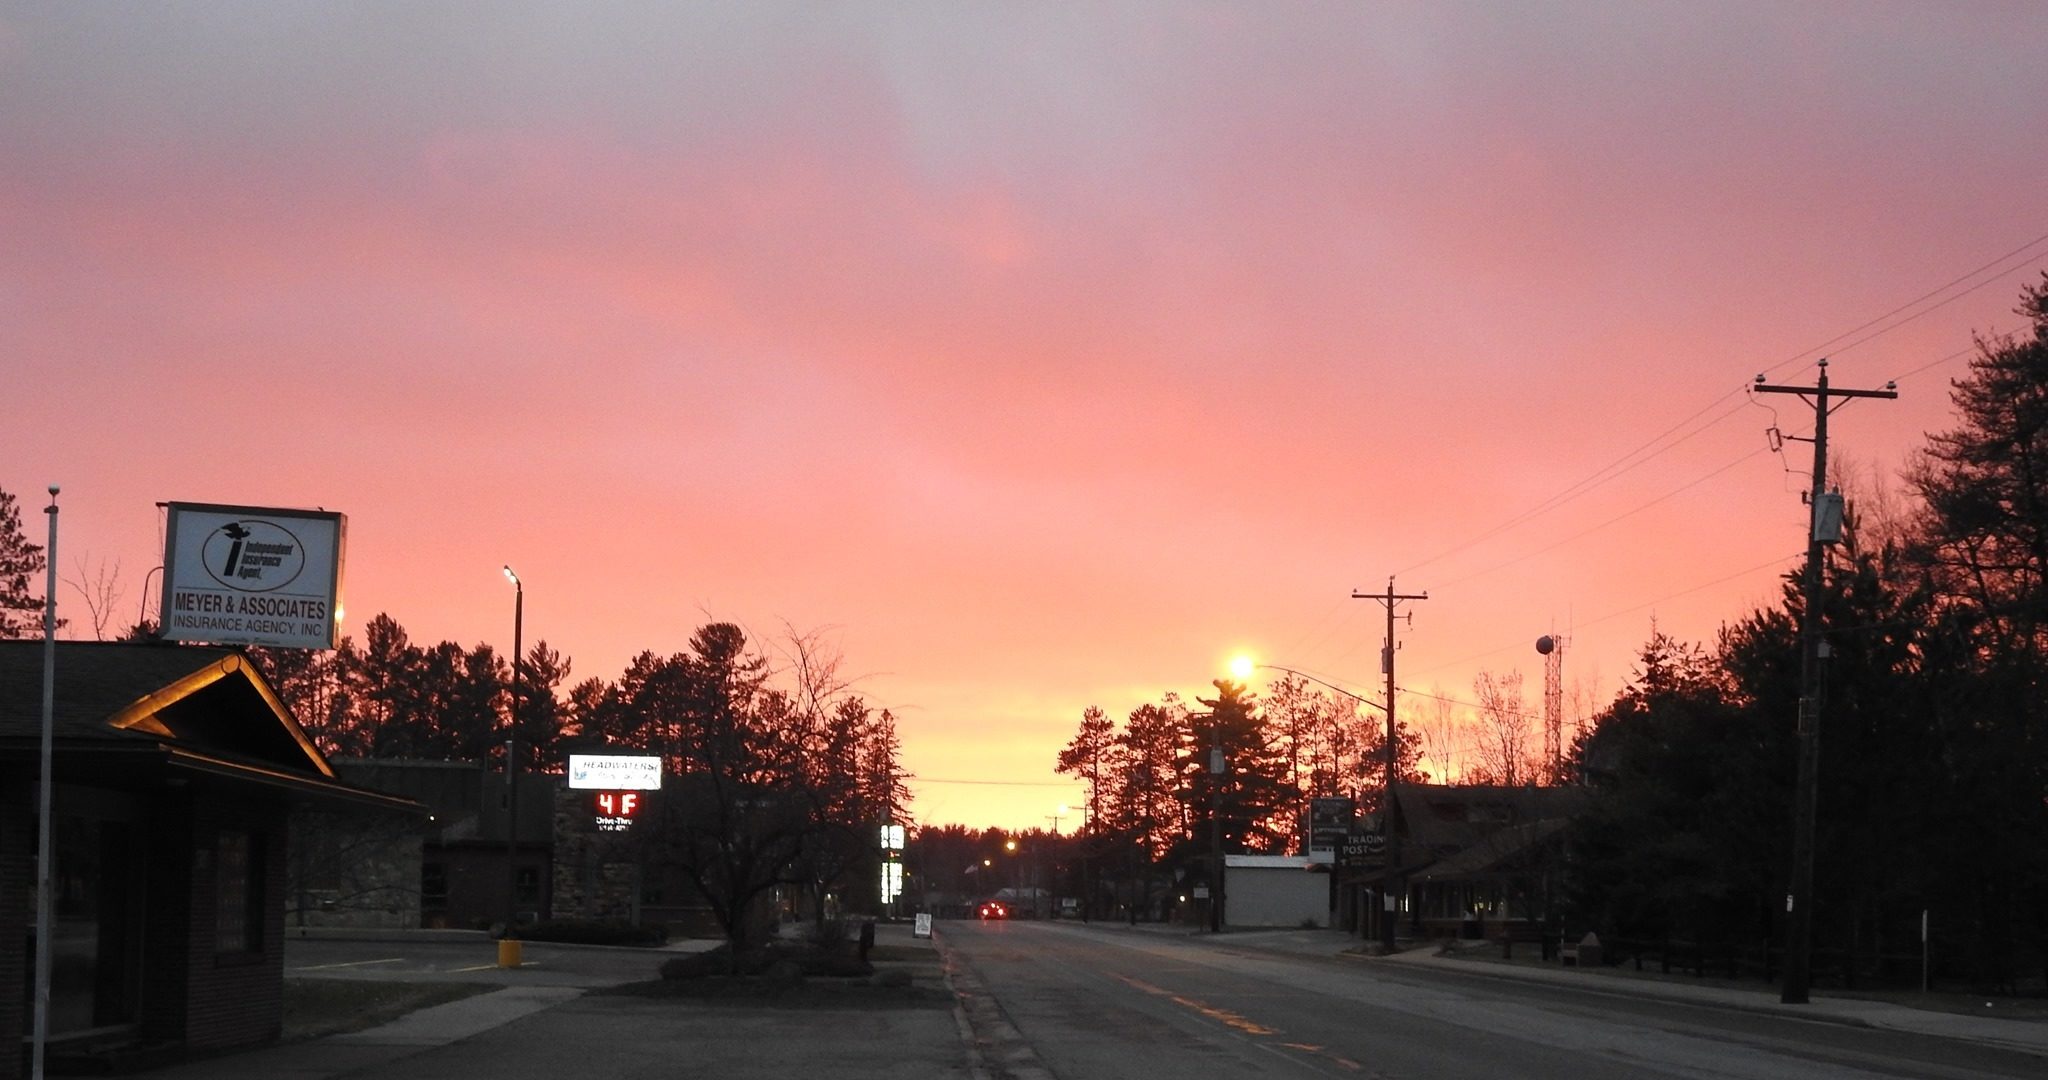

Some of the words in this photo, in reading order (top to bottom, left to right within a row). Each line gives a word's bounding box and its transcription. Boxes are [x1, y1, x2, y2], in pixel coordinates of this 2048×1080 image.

[244, 541, 293, 555] Independent
[241, 554, 281, 567] Insurance
[175, 592, 222, 612] MEYER
[226, 595, 234, 613] &
[239, 597, 326, 619] ASSOCIATES
[174, 615, 242, 631] INSURANCE
[600, 794, 612, 814] 4
[621, 794, 637, 814] F
[1347, 834, 1386, 845] TRADIN
[1342, 845, 1369, 855] POST
